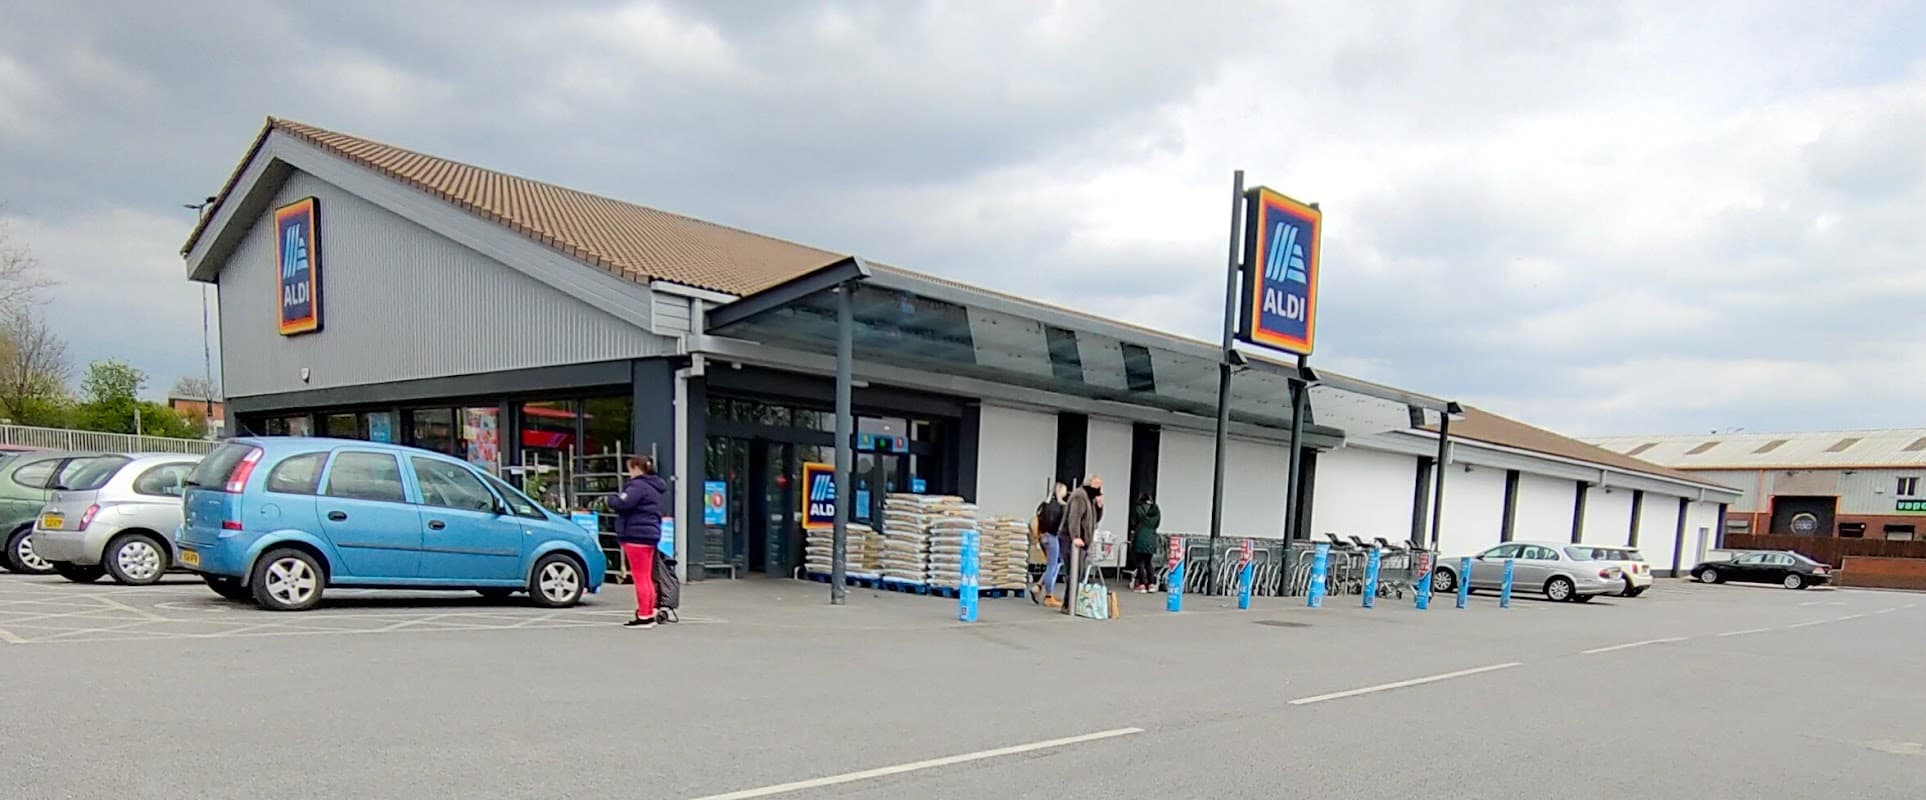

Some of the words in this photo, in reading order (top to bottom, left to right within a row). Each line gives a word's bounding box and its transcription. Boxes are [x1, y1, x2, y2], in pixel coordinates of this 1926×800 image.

[284, 281, 309, 307] ALDI
[1263, 287, 1305, 322] ALDI
[810, 503, 835, 516] ALD
